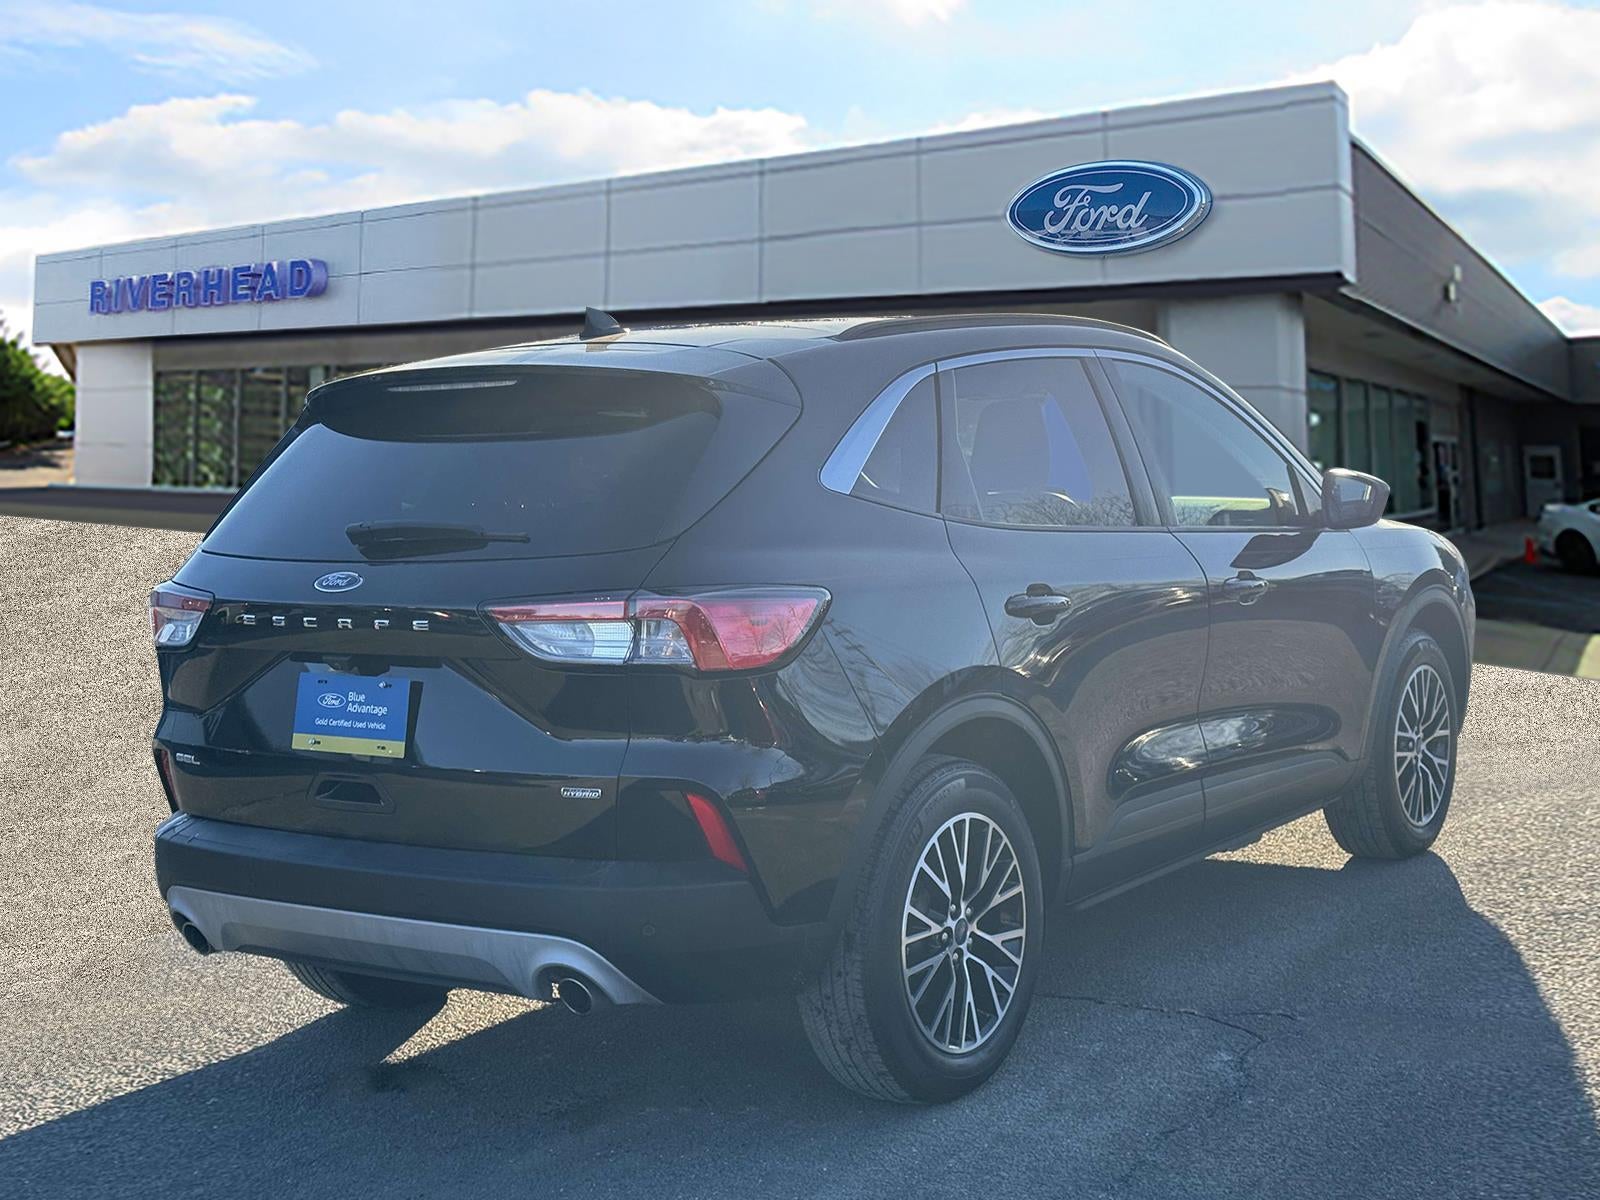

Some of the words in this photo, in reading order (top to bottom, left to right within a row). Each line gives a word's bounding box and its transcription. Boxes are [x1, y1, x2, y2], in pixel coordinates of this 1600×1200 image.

[1043, 182, 1152, 235] Ford
[89, 259, 323, 315] RIVERHEAD
[242, 614, 430, 631] ESCAPE
[348, 691, 366, 702] Blue
[346, 703, 388, 716] Advantage
[315, 717, 328, 726] Gold
[328, 718, 352, 728] Certified
[353, 720, 367, 729] Used
[367, 721, 386, 730] Vehicle
[563, 790, 599, 798] HYBRID
